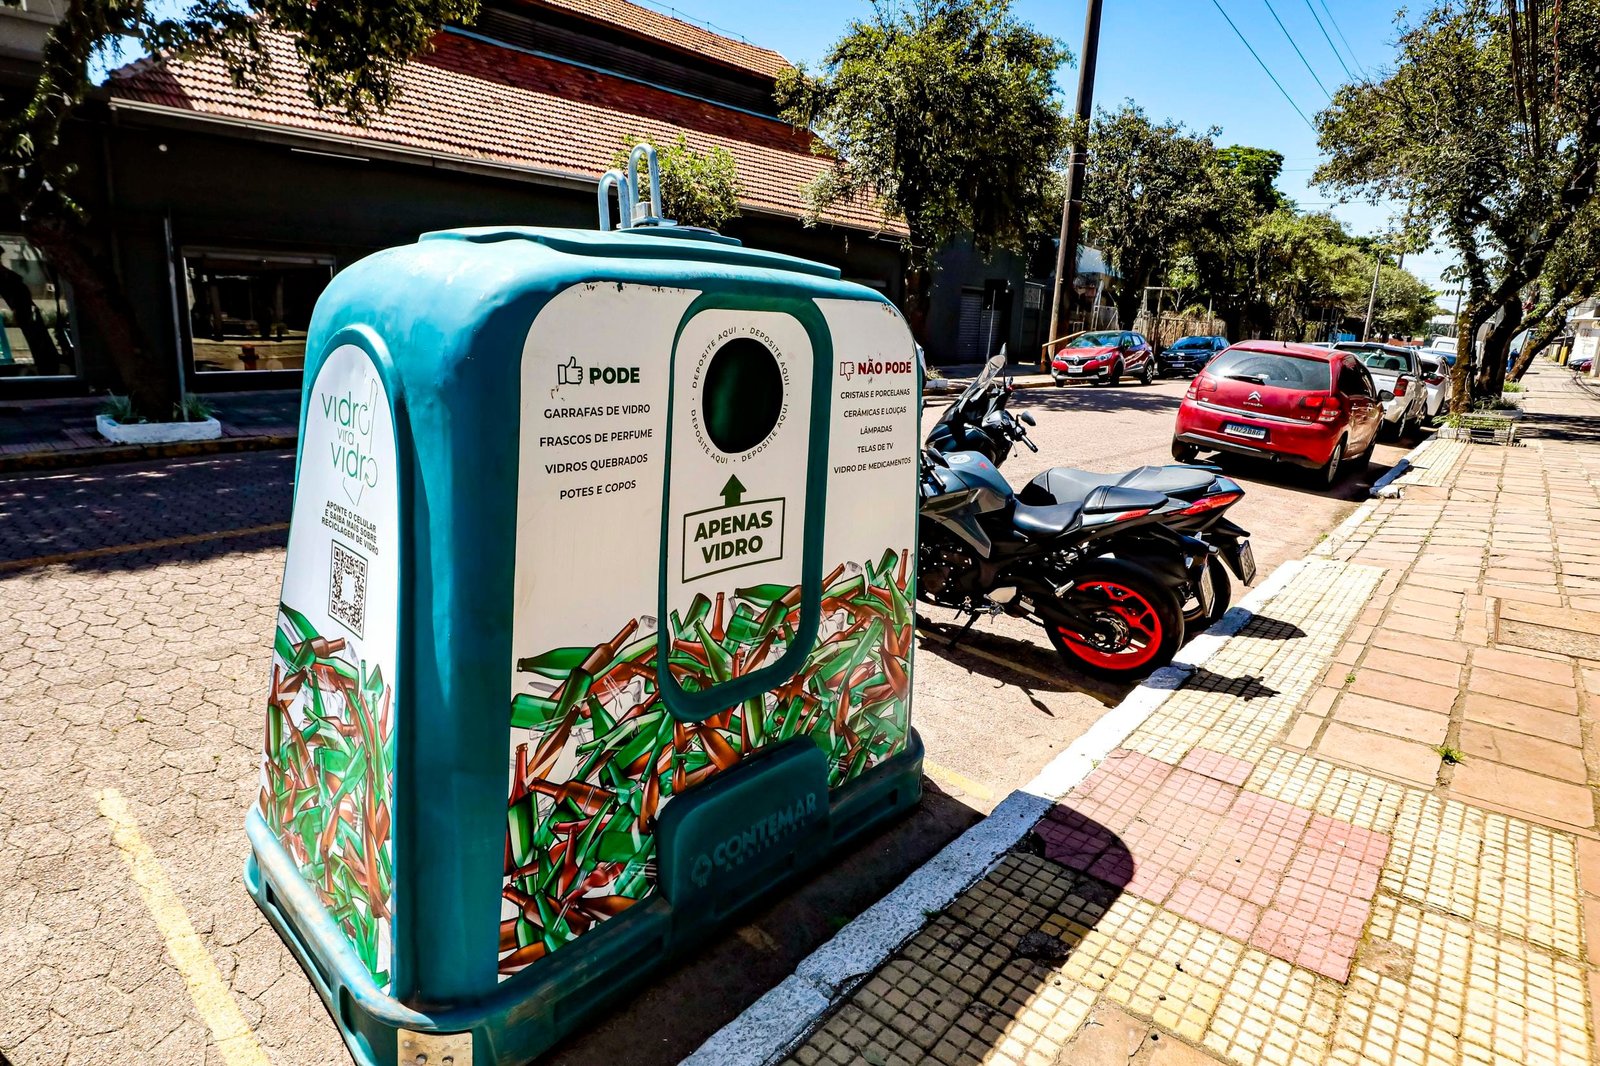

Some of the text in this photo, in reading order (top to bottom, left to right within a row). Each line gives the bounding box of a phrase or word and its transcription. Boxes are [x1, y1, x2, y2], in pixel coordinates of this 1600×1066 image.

[692, 326, 737, 389] DEPOSITE AQUI
[749, 327, 790, 386] DEPOSITE AQUI
[589, 367, 640, 385] PODE
[858, 359, 912, 375] NÃO PODE
[840, 390, 869, 399] CRISTAIS
[875, 388, 910, 397] PORCELANAS
[544, 404, 651, 419] GARRAFAS DE VIDRO
[844, 408, 880, 418] CERÂMICAS
[886, 406, 907, 415] LOUÇAS
[337, 427, 354, 446] vira
[540, 429, 653, 447] FRASCOS DE PERFUME
[690, 409, 729, 465] DEPOSITE AQUI
[741, 403, 789, 462] DEPOSITE AQUI
[860, 425, 893, 435] LÂMPADAS
[857, 444, 877, 453] TELAS
[878, 443, 886, 451] DE
[545, 454, 648, 474] VIDROS QUEBRADOS
[834, 465, 857, 474] VIDRO
[868, 457, 912, 470] MEDICAMENTOS
[560, 480, 636, 500] POTES E COPOS
[325, 508, 377, 544] E SAIBA MAIS SOBRE
[326, 500, 377, 533] APONTE O CELULAR
[694, 510, 773, 542] APENAS
[321, 516, 379, 556] RECICLAGEM DE VIDRO
[701, 535, 764, 564] VIDRO
[713, 792, 817, 866] CONTEMAR
